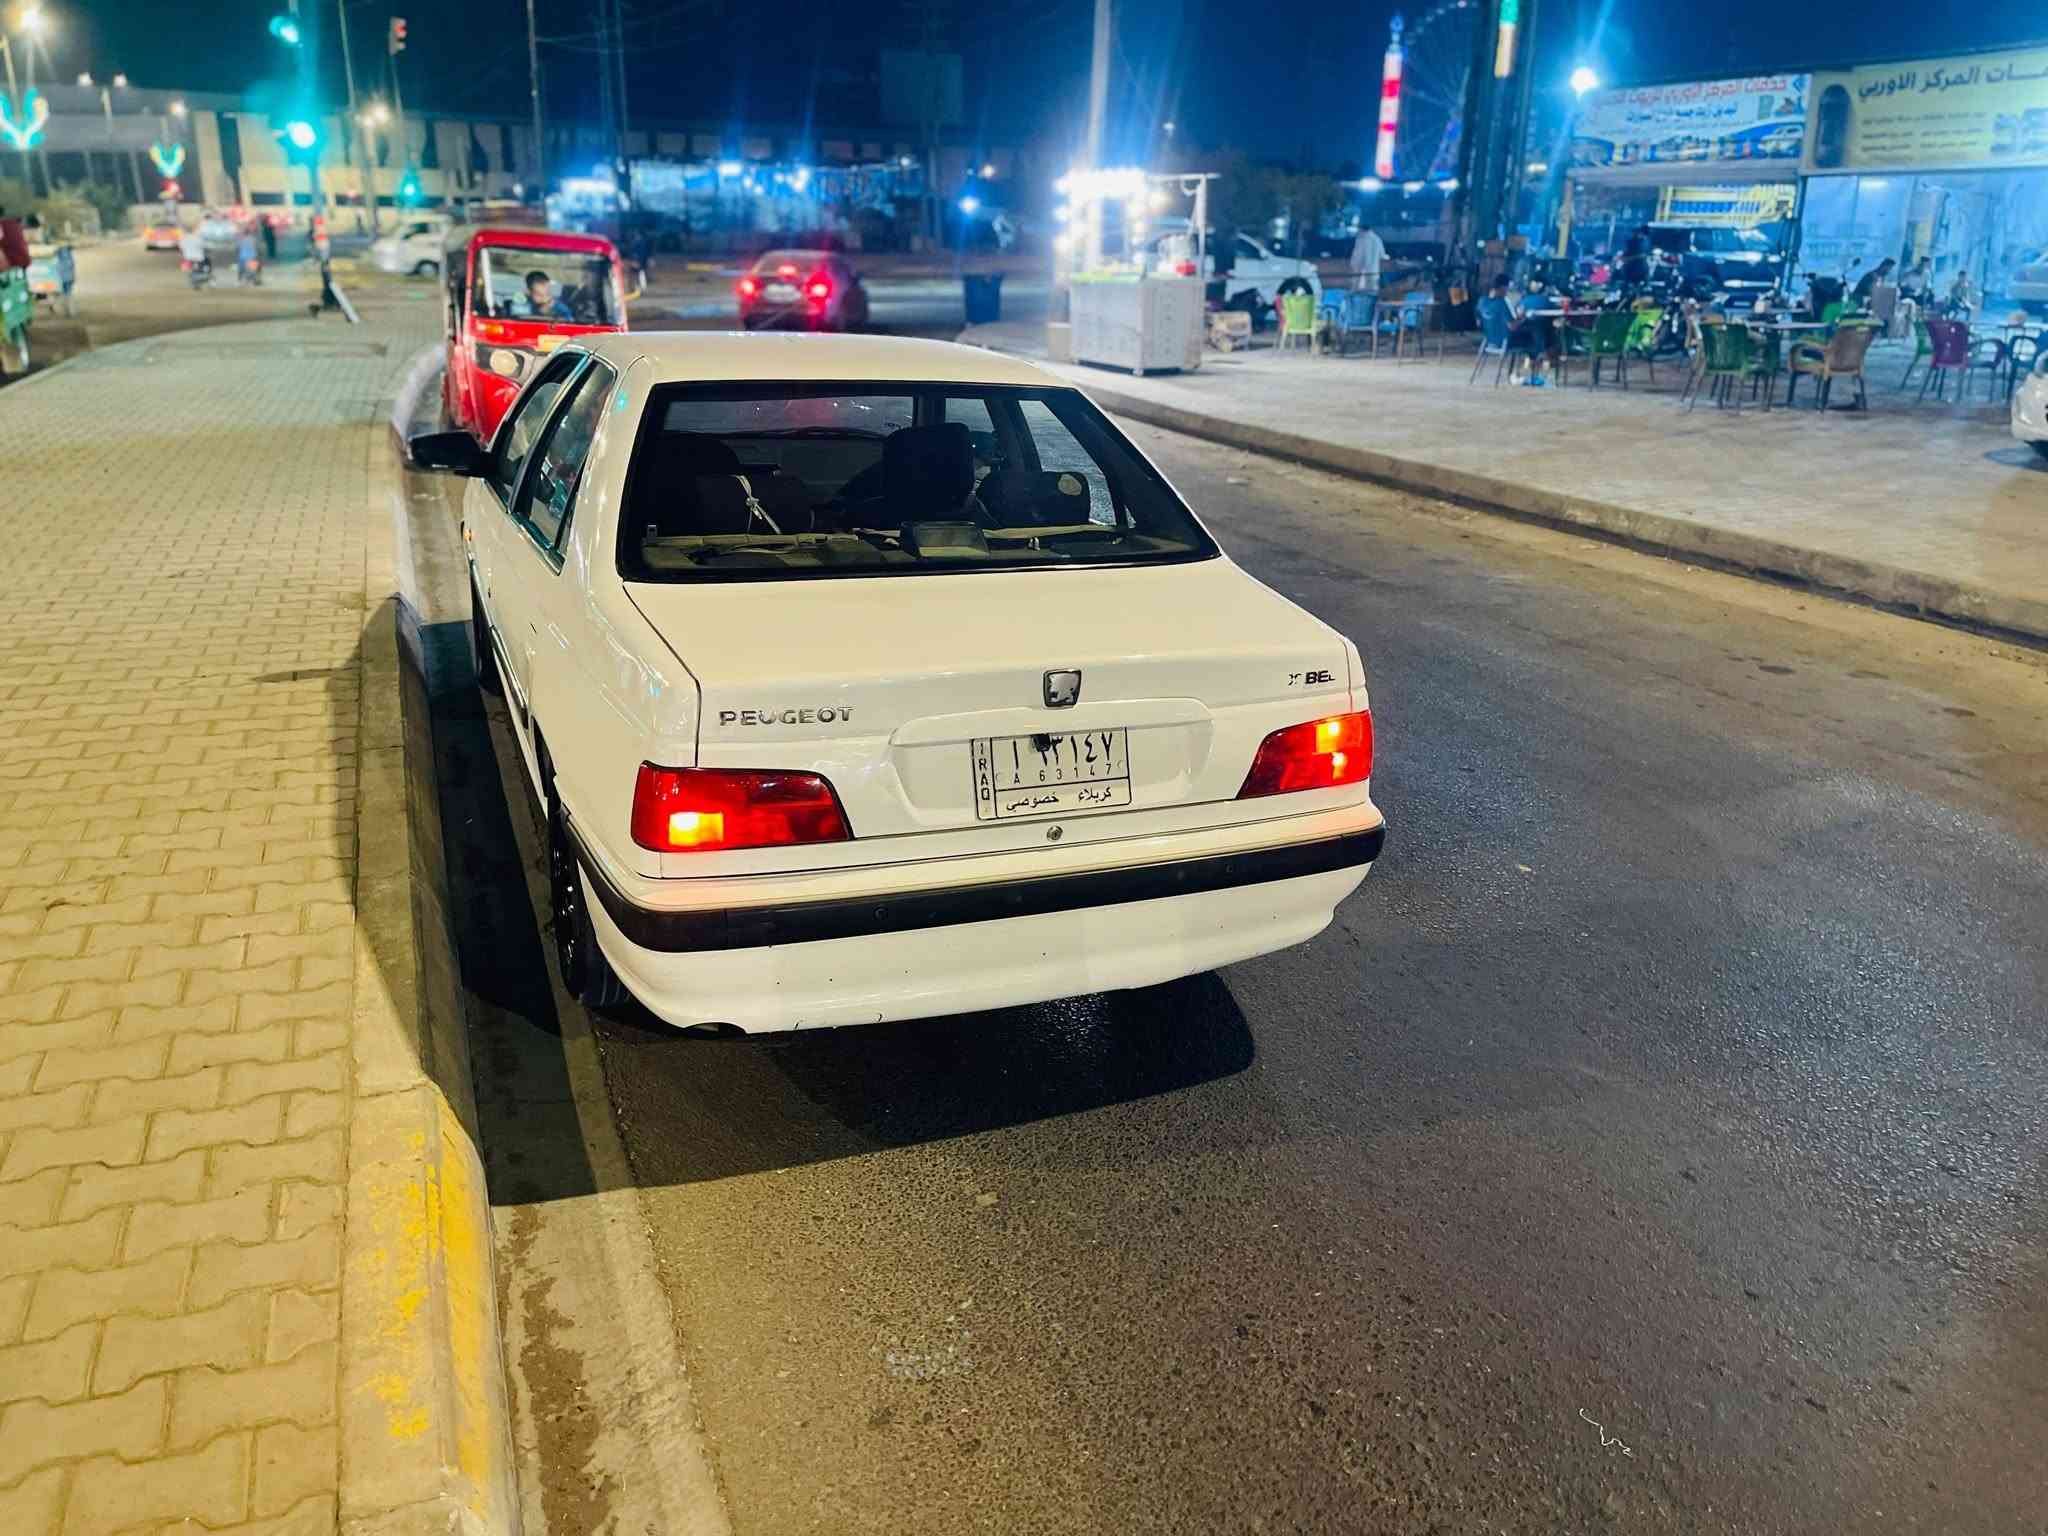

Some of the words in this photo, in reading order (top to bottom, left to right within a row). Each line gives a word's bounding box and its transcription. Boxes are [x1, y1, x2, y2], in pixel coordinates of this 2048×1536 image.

[1919, 66, 1980, 93] المركز
[719, 706, 855, 726] PEUGEOT
[978, 742, 991, 801] IRAQ
[1013, 772, 1021, 785] A
[1006, 791, 1060, 813] خصوصي
[1078, 786, 1113, 804] كربلاء
